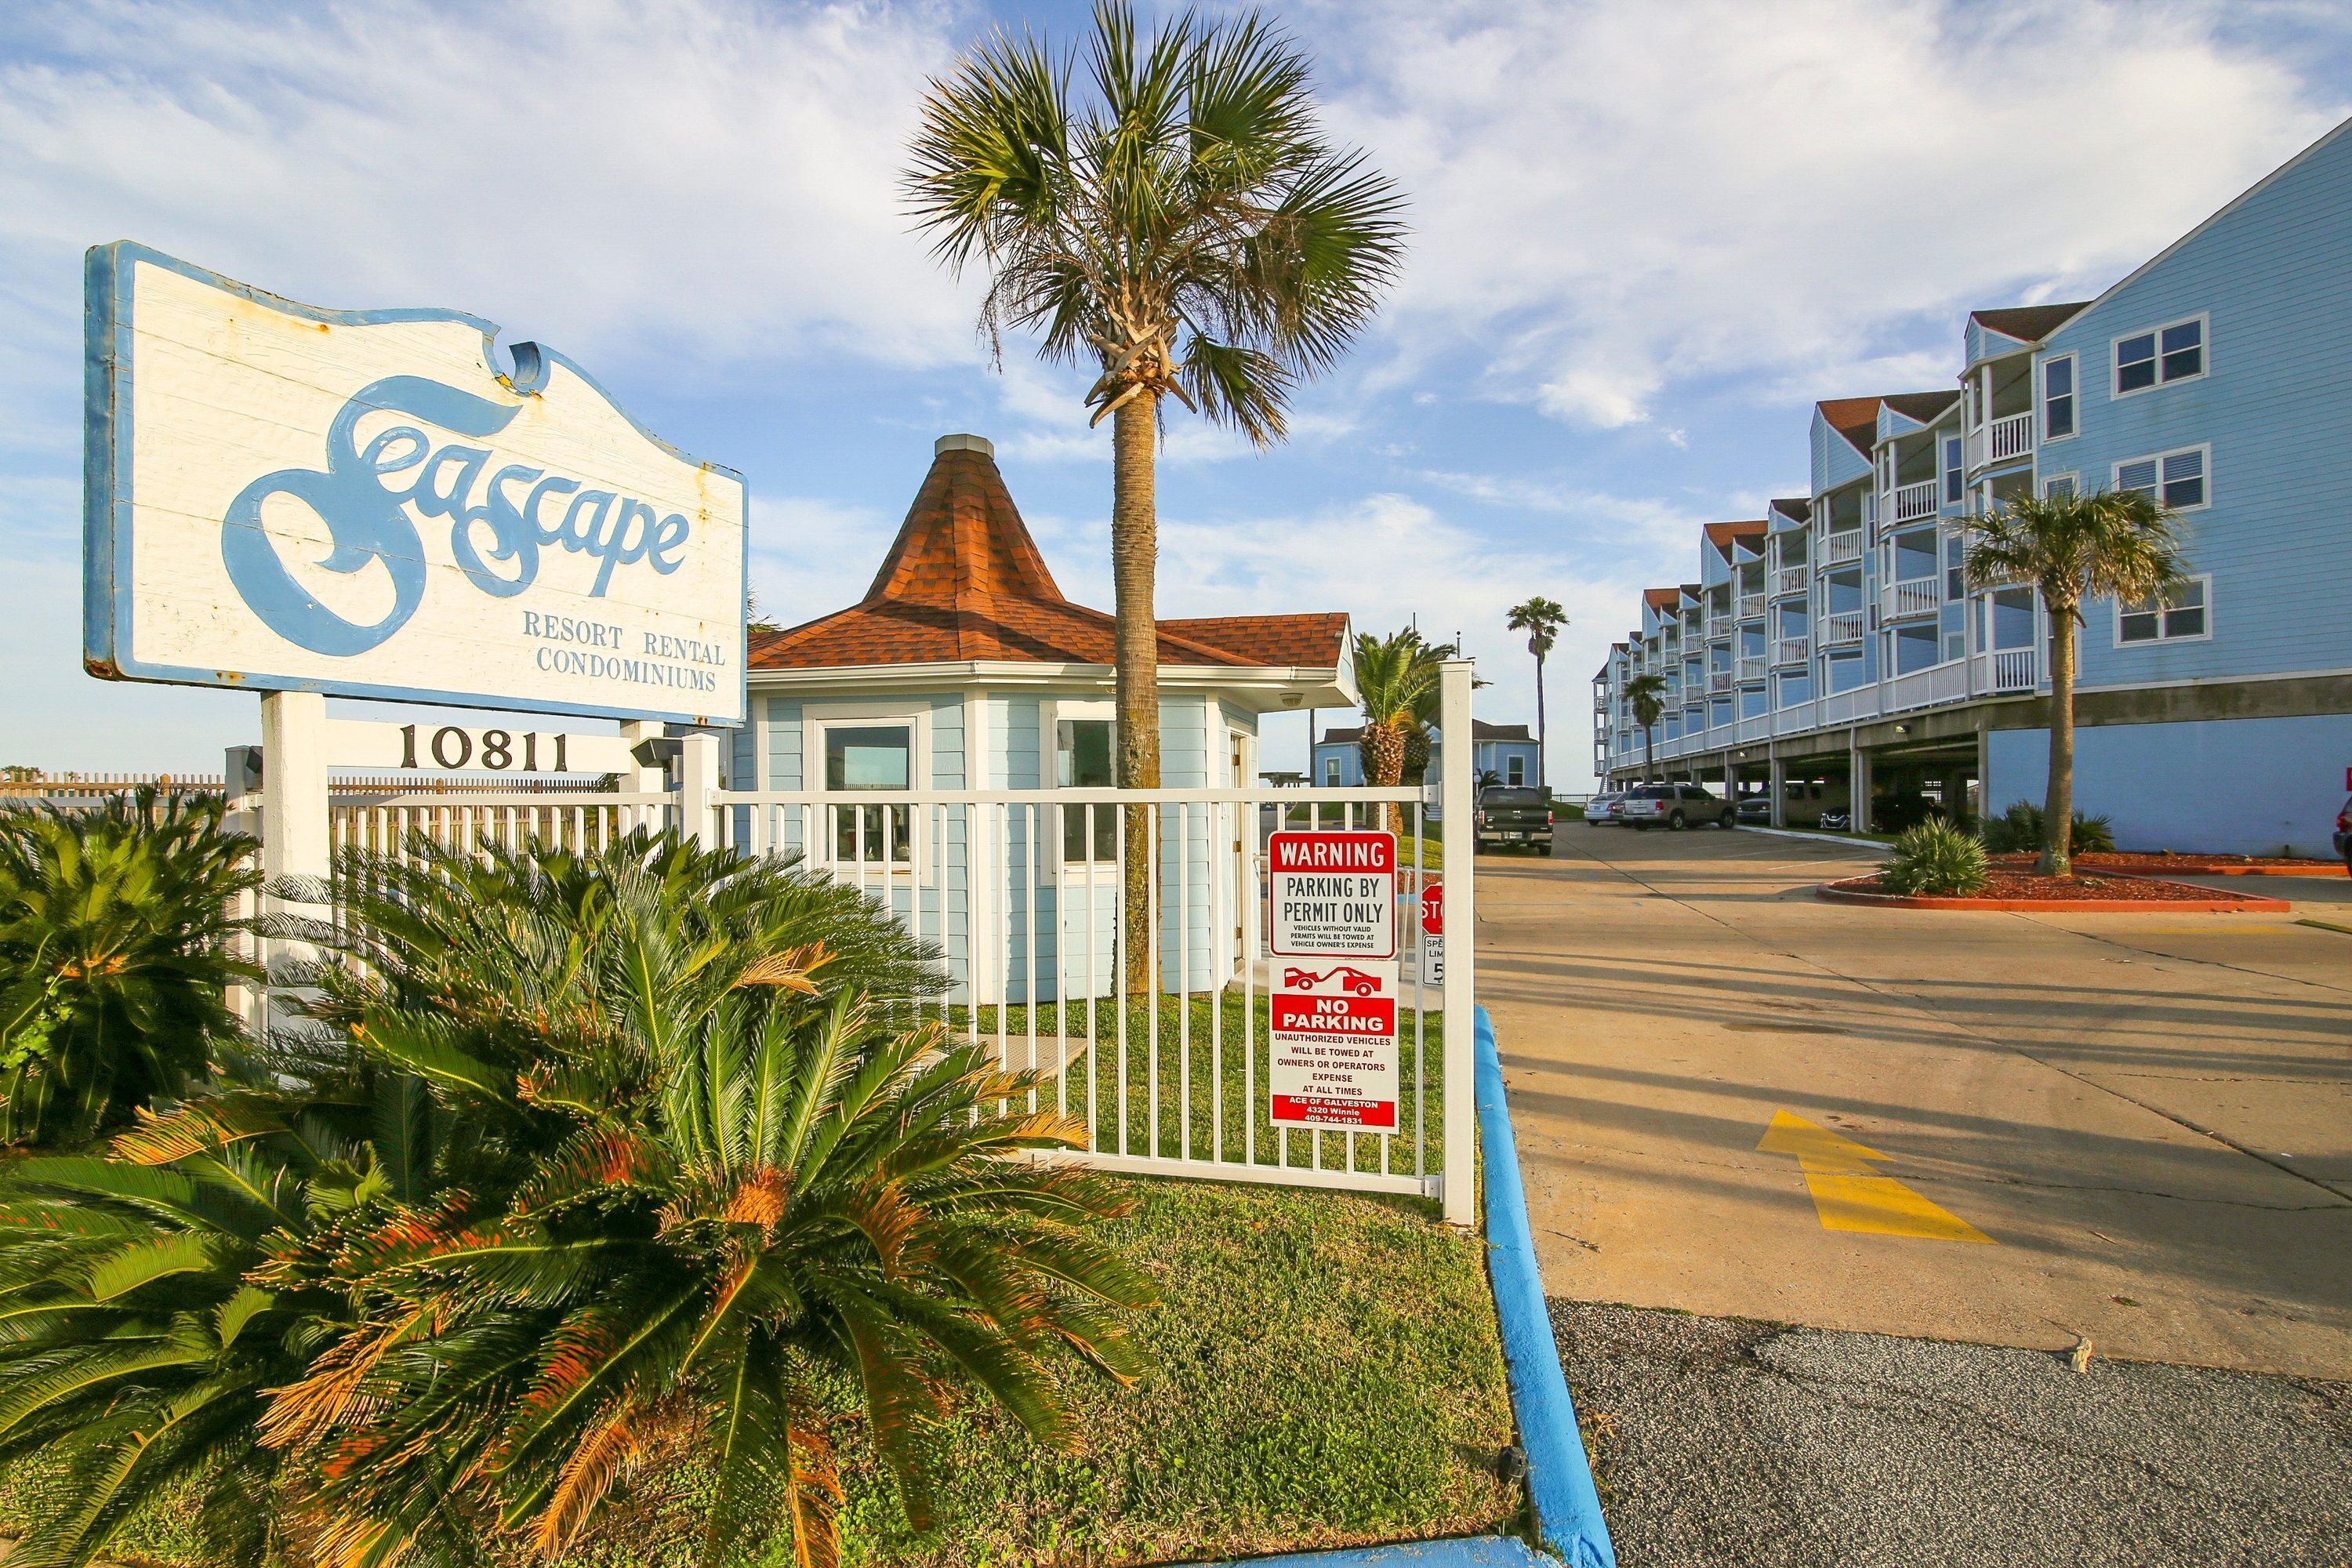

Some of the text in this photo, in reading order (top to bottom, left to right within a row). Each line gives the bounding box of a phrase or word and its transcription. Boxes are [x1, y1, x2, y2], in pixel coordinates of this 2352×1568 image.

[221, 376, 690, 656] Seascape
[522, 611, 726, 666] RESORT RENTAL
[536, 648, 715, 691] CONDOMINIUMS
[400, 724, 568, 772] 10811
[1279, 842, 1385, 867] WARNING
[1287, 877, 1379, 898] PARKING BY
[1284, 902, 1382, 923] PERMIT ONLY
[1422, 901, 1443, 919] ST
[1316, 1000, 1348, 1014] NO
[1283, 1014, 1384, 1031] PARKING
[1276, 1033, 1391, 1046] UNAUTHORIZED VEHICLES
[1278, 1059, 1315, 1068] OWNERS
[1332, 1062, 1385, 1071] OPERATORS
[1312, 1073, 1352, 1082] EXPENSE
[1324, 1099, 1378, 1108] GALVESTON
[1305, 1116, 1363, 1124] 409-744-1831
